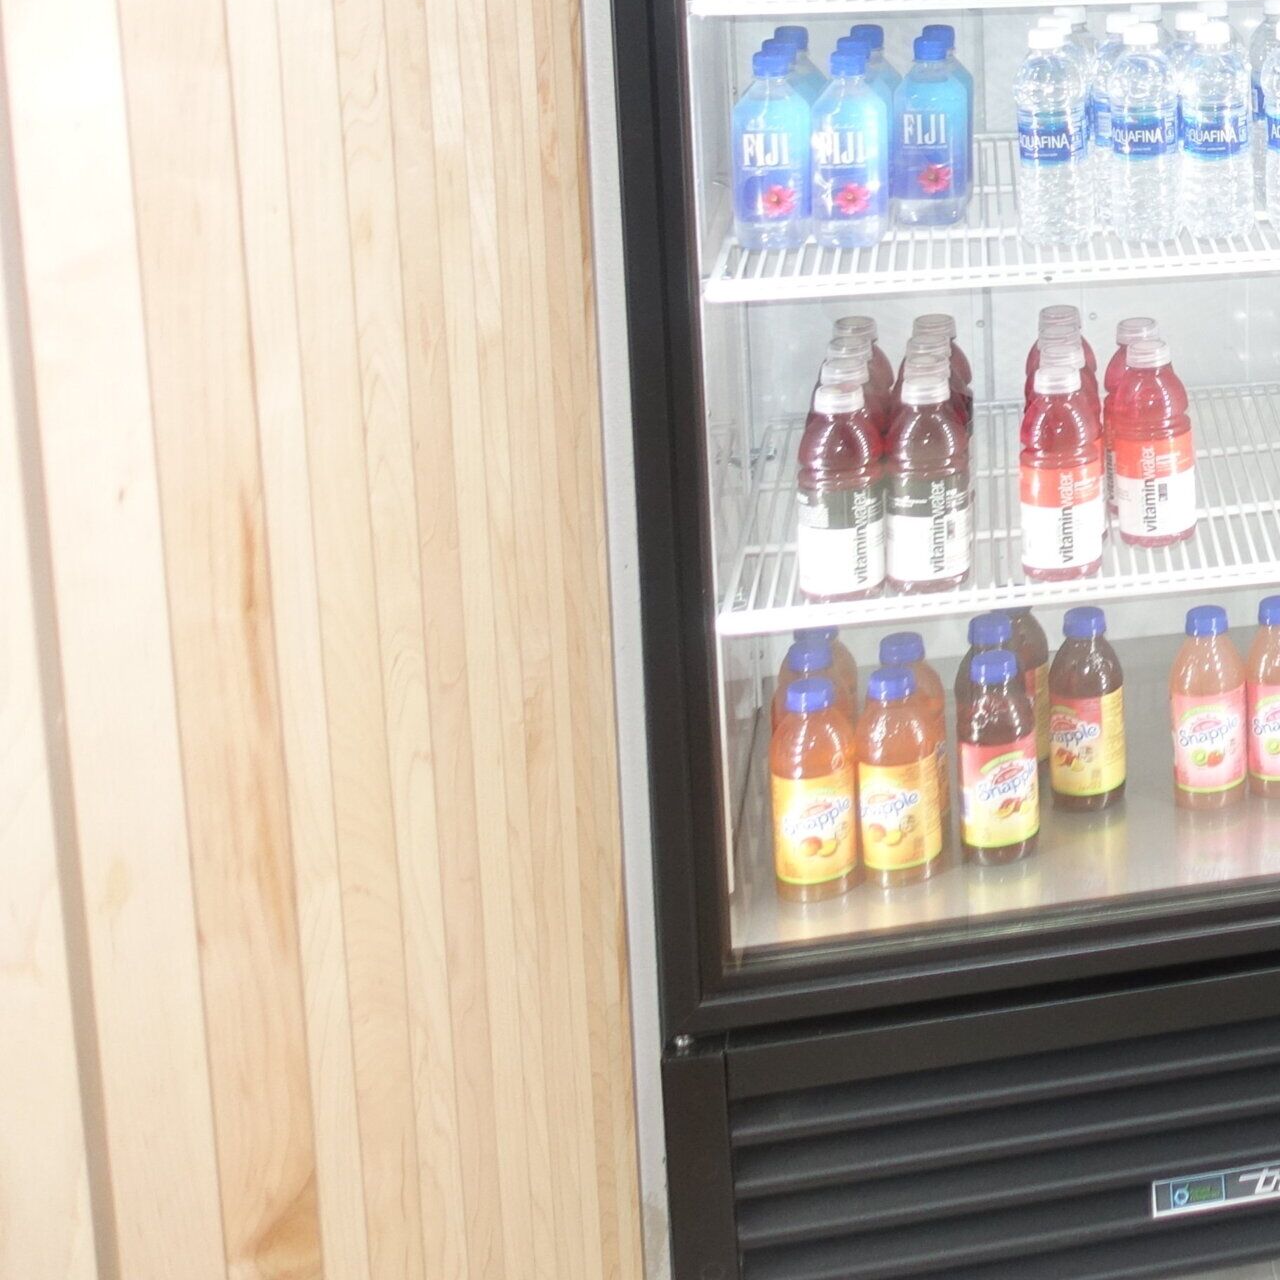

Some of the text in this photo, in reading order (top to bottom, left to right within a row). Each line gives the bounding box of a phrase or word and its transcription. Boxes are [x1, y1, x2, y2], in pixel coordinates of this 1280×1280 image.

[903, 113, 947, 146] FIJI
[742, 132, 790, 167] FIJI
[818, 131, 867, 166] FIJI
[1143, 446, 1156, 534] vitaminwater
[929, 480, 946, 575] vitaminwater
[1056, 471, 1074, 565] vitaminwater
[853, 489, 868, 585] vitaminwater
[1050, 722, 1098, 748] napple
[1178, 716, 1238, 748] Snapple
